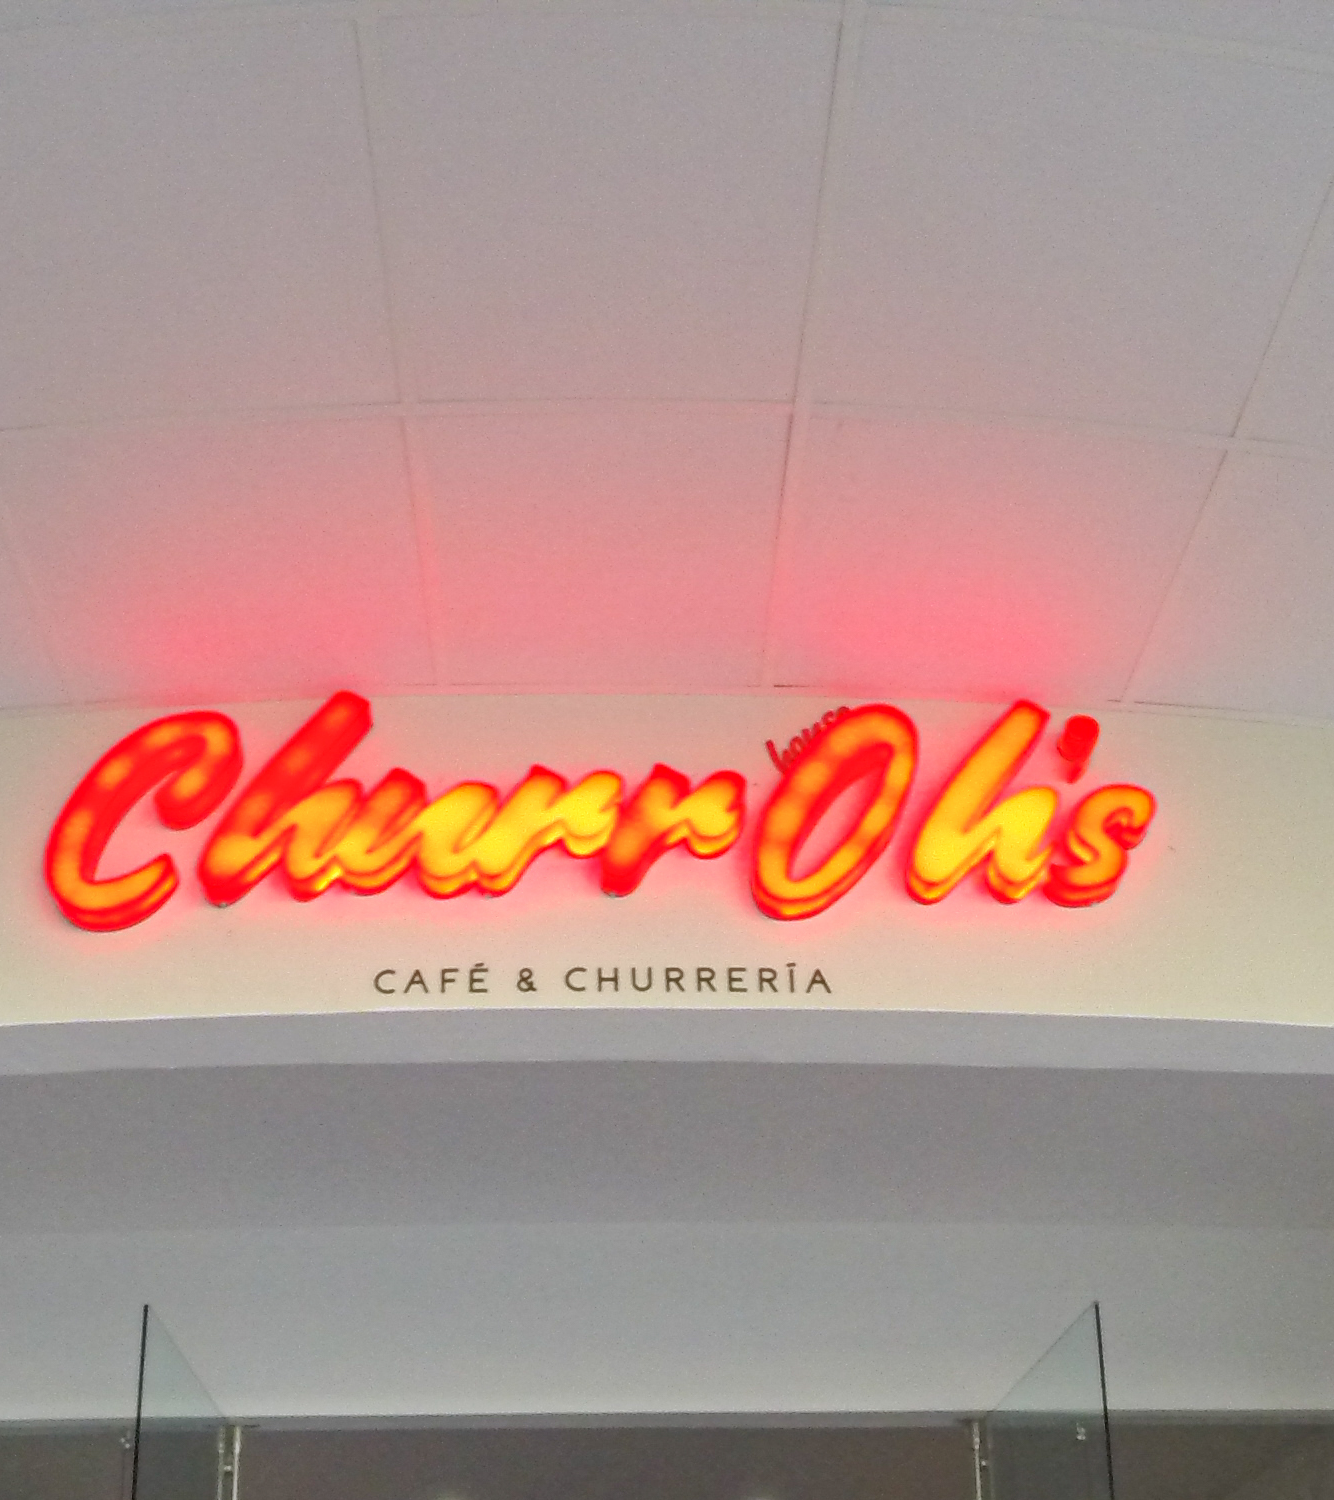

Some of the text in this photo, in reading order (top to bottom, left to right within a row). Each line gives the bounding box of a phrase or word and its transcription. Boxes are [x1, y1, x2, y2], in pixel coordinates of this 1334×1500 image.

[373, 962, 833, 994] CAFÉ & CHURRERÍA
